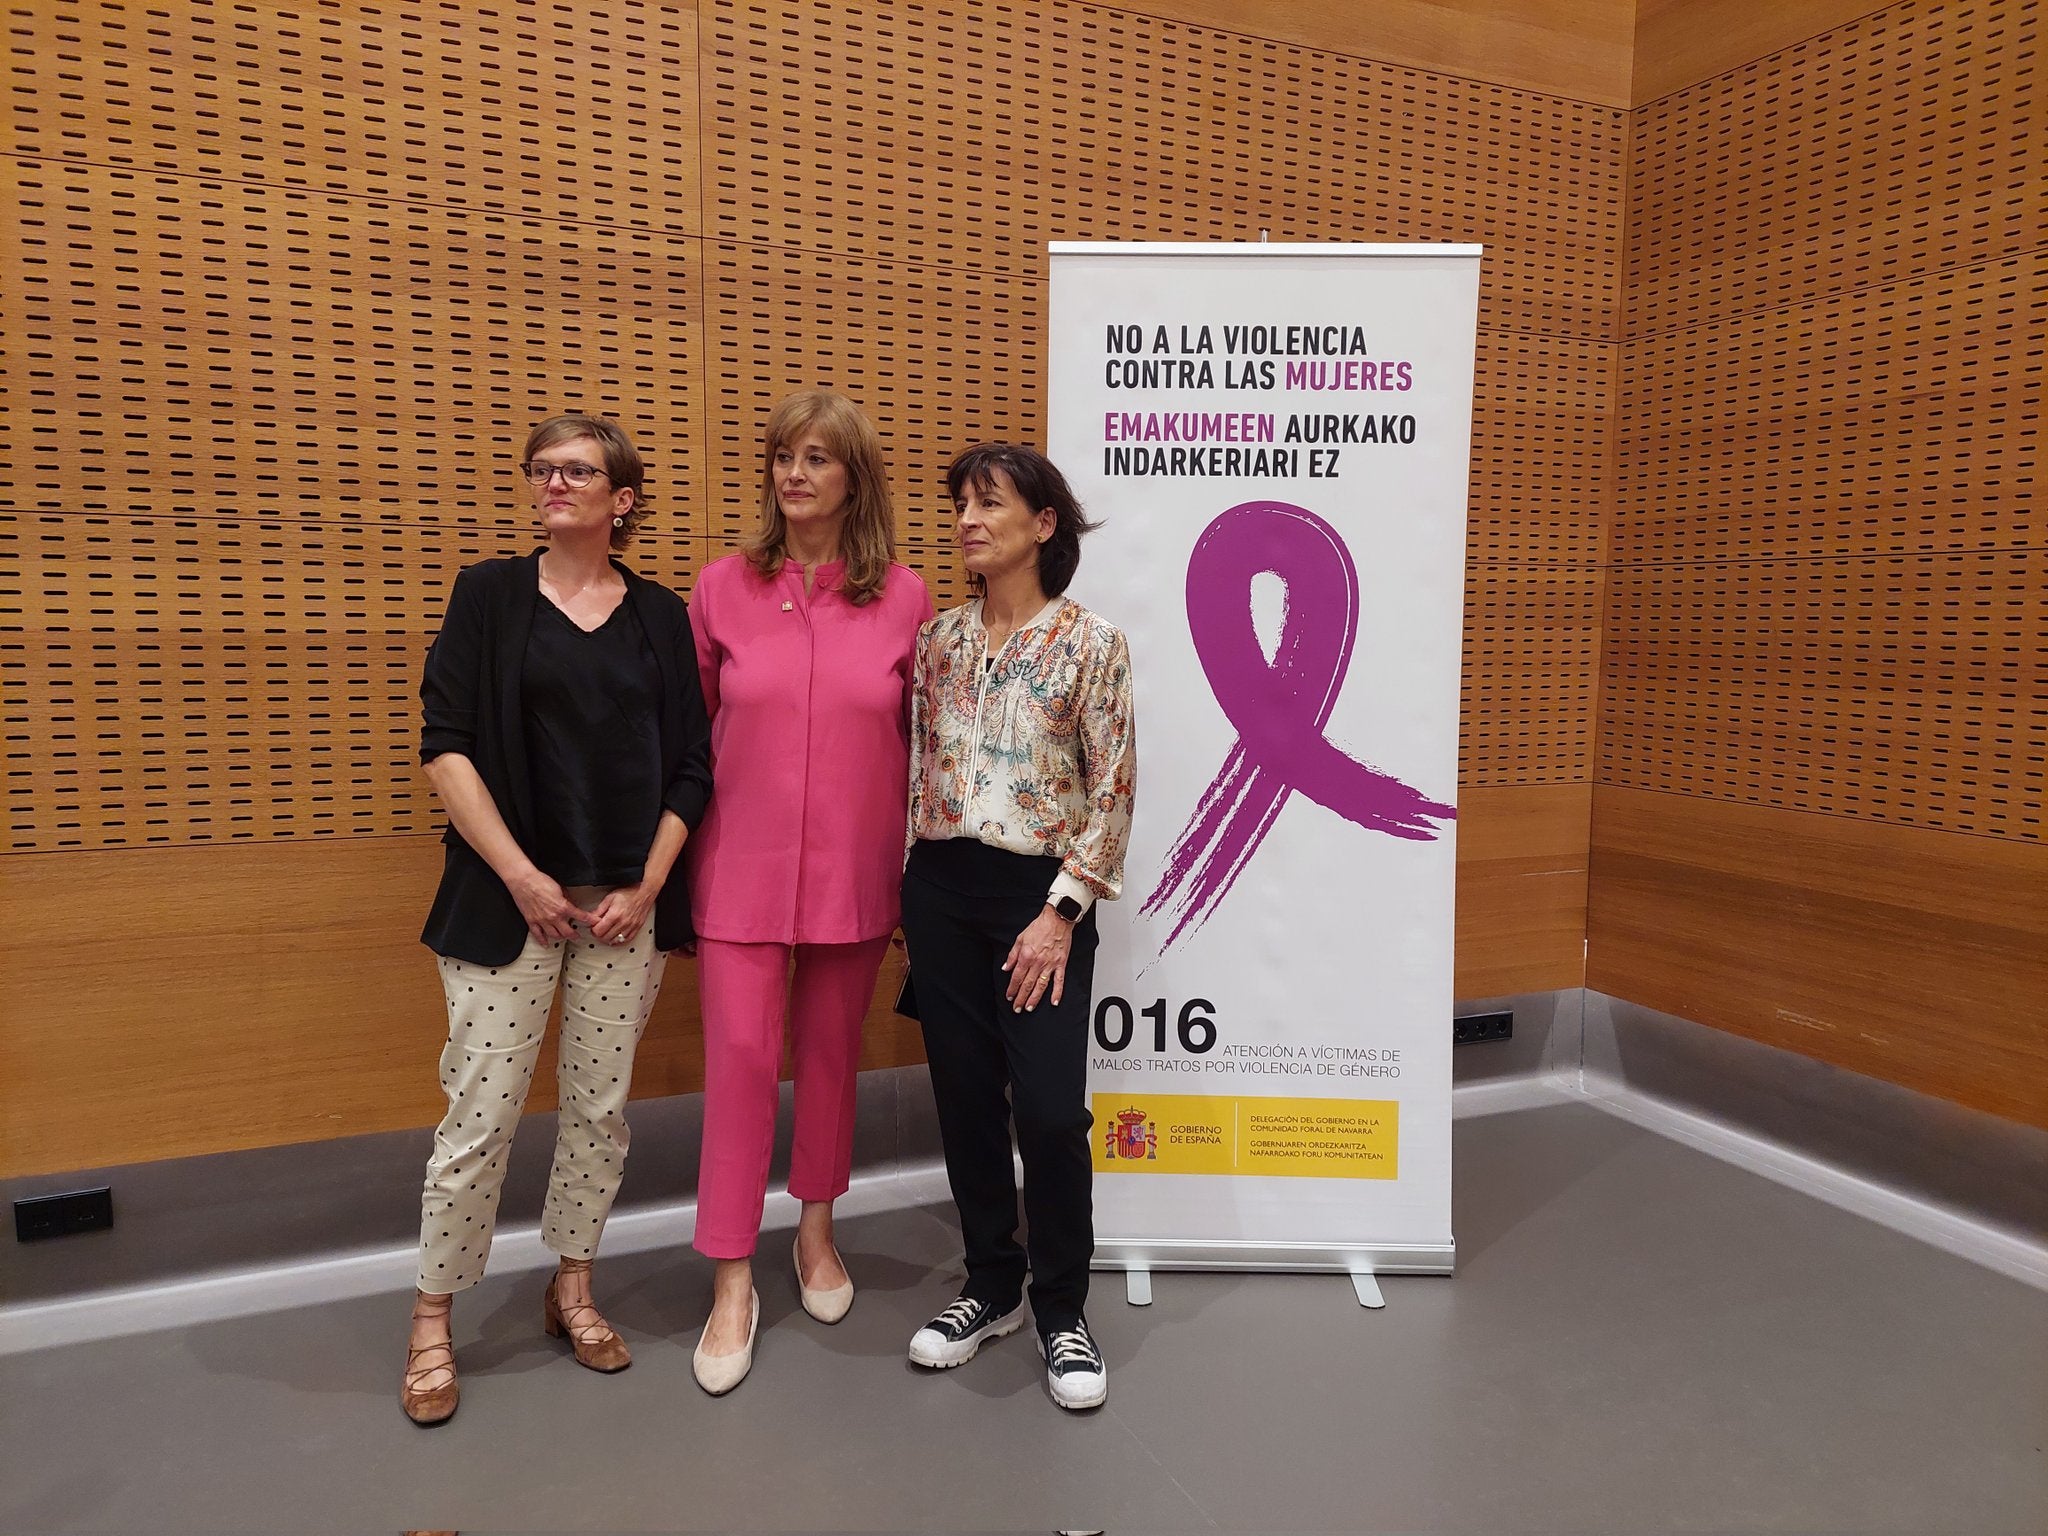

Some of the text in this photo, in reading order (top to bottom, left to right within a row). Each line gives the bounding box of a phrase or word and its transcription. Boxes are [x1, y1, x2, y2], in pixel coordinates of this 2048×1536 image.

[1106, 324, 1367, 356] NO A LA VIOLENCIA
[1105, 359, 1413, 391] CONTRA LAS MUJERES
[1104, 412, 1416, 444] EMAKUMEEN AURKAKO
[1104, 447, 1340, 478] INDARKERIARI EZ
[1093, 996, 1217, 1054] 016
[1223, 1043, 1401, 1062] ATENCIÓN A VÍCTIMAS DE
[1092, 1058, 1401, 1078] MALOS TRATOS POR VIOLENCIA DE GÉNERO
[1250, 1115, 1298, 1124] DELEGACIÓN
[1300, 1116, 1314, 1124] DEL
[1316, 1117, 1356, 1125] GOBIERNO
[1170, 1125, 1222, 1135] GOBIERNO
[1170, 1134, 1222, 1144] DE ESPAÑA
[1250, 1125, 1298, 1133] COMUNIDAD
[1326, 1126, 1336, 1134] DE
[1338, 1127, 1373, 1135] NAVARRA
[1250, 1140, 1366, 1150] GOBERNUAREN ORDEZKARITZA
[1250, 1149, 1383, 1160] NAFARROAKO FORU KOMUNITATEAN
